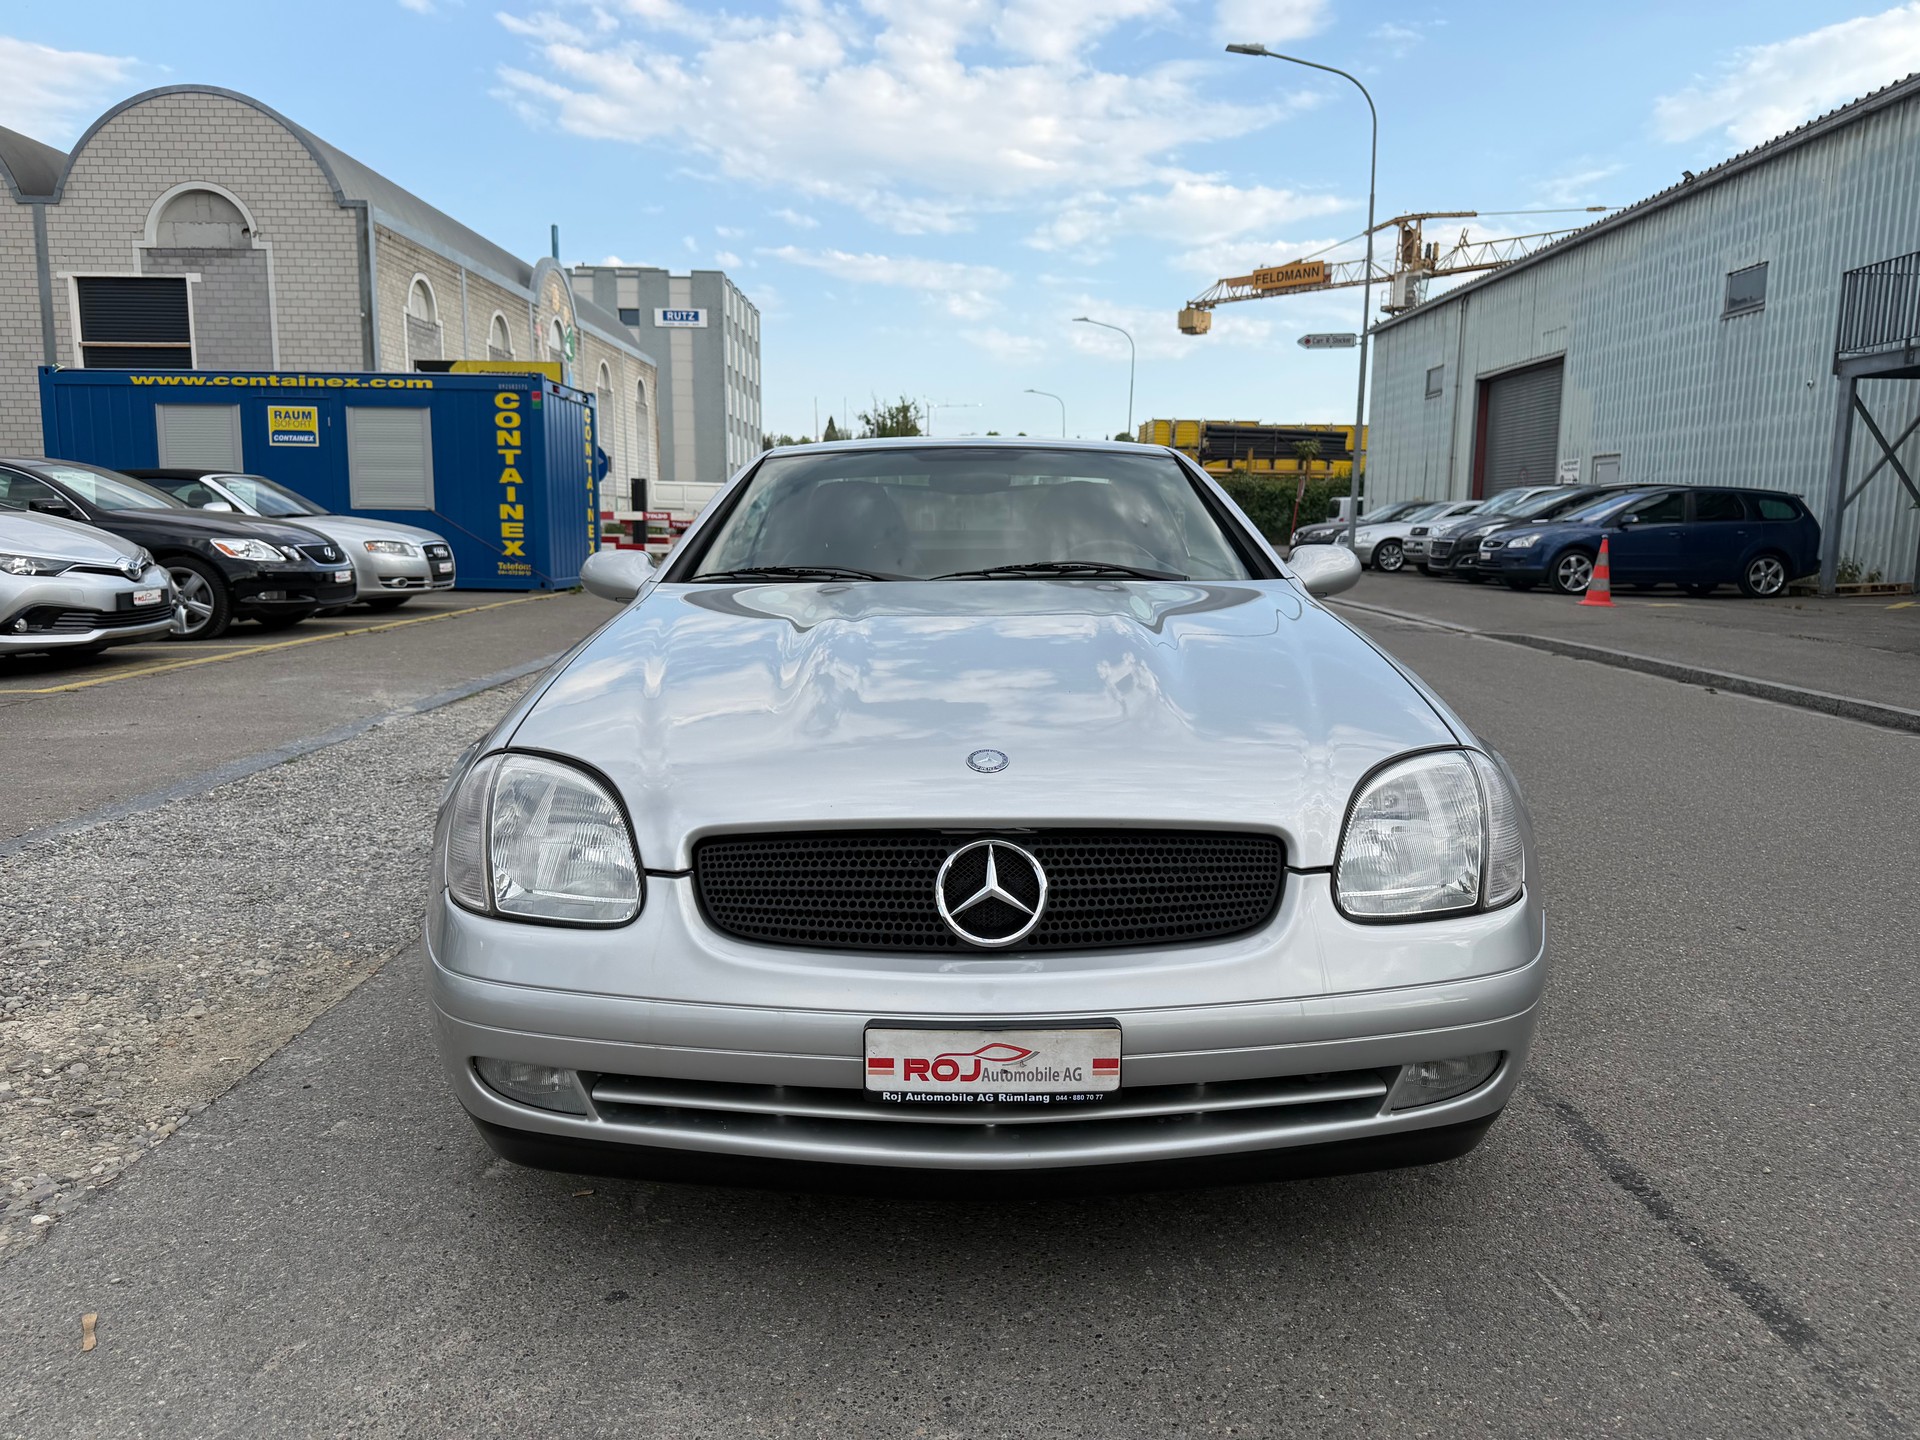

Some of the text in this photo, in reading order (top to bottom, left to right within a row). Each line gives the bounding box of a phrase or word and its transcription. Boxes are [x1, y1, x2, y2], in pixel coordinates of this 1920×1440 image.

[1255, 266, 1320, 286] FELDMANN
[666, 311, 695, 321] RUTZ
[129, 374, 434, 389] www.containex.com
[274, 410, 312, 420] RAUM
[274, 419, 312, 428] SOFORT
[273, 434, 315, 442] CONTAINEX
[494, 392, 526, 556] CONTAINEX
[583, 407, 596, 554] CONTAINEX
[903, 1058, 1083, 1082] ROJ Automobile AG
[882, 1091, 902, 1103] Roj
[905, 1092, 974, 1102] Automobile
[976, 1093, 994, 1102] AG
[998, 1093, 1050, 1104] Rümlang
